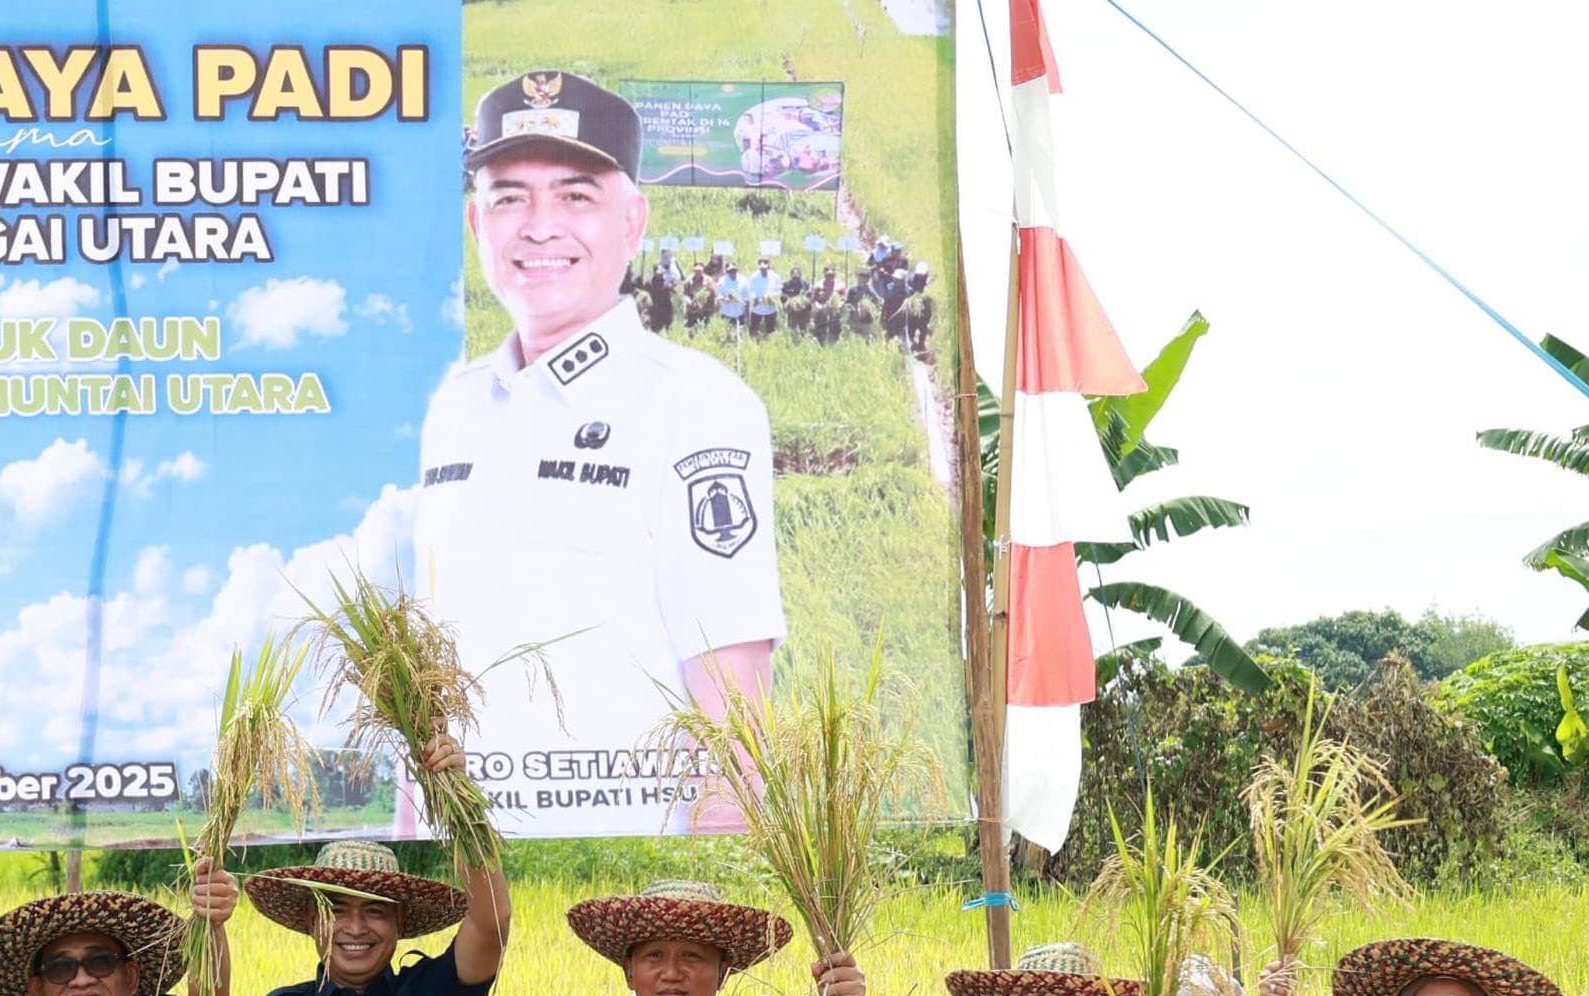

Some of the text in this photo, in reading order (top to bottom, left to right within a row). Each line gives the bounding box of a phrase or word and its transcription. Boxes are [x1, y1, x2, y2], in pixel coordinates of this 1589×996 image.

[192, 44, 429, 123] PADI
[154, 157, 370, 206] BUPATI
[78, 213, 275, 265] UTARA
[66, 316, 221, 362] DAUN
[166, 373, 331, 416] UTARA
[579, 463, 631, 488] BUPATI
[65, 762, 177, 801] 2025
[536, 787, 632, 810] BUPATI
[641, 785, 698, 805] HSU
